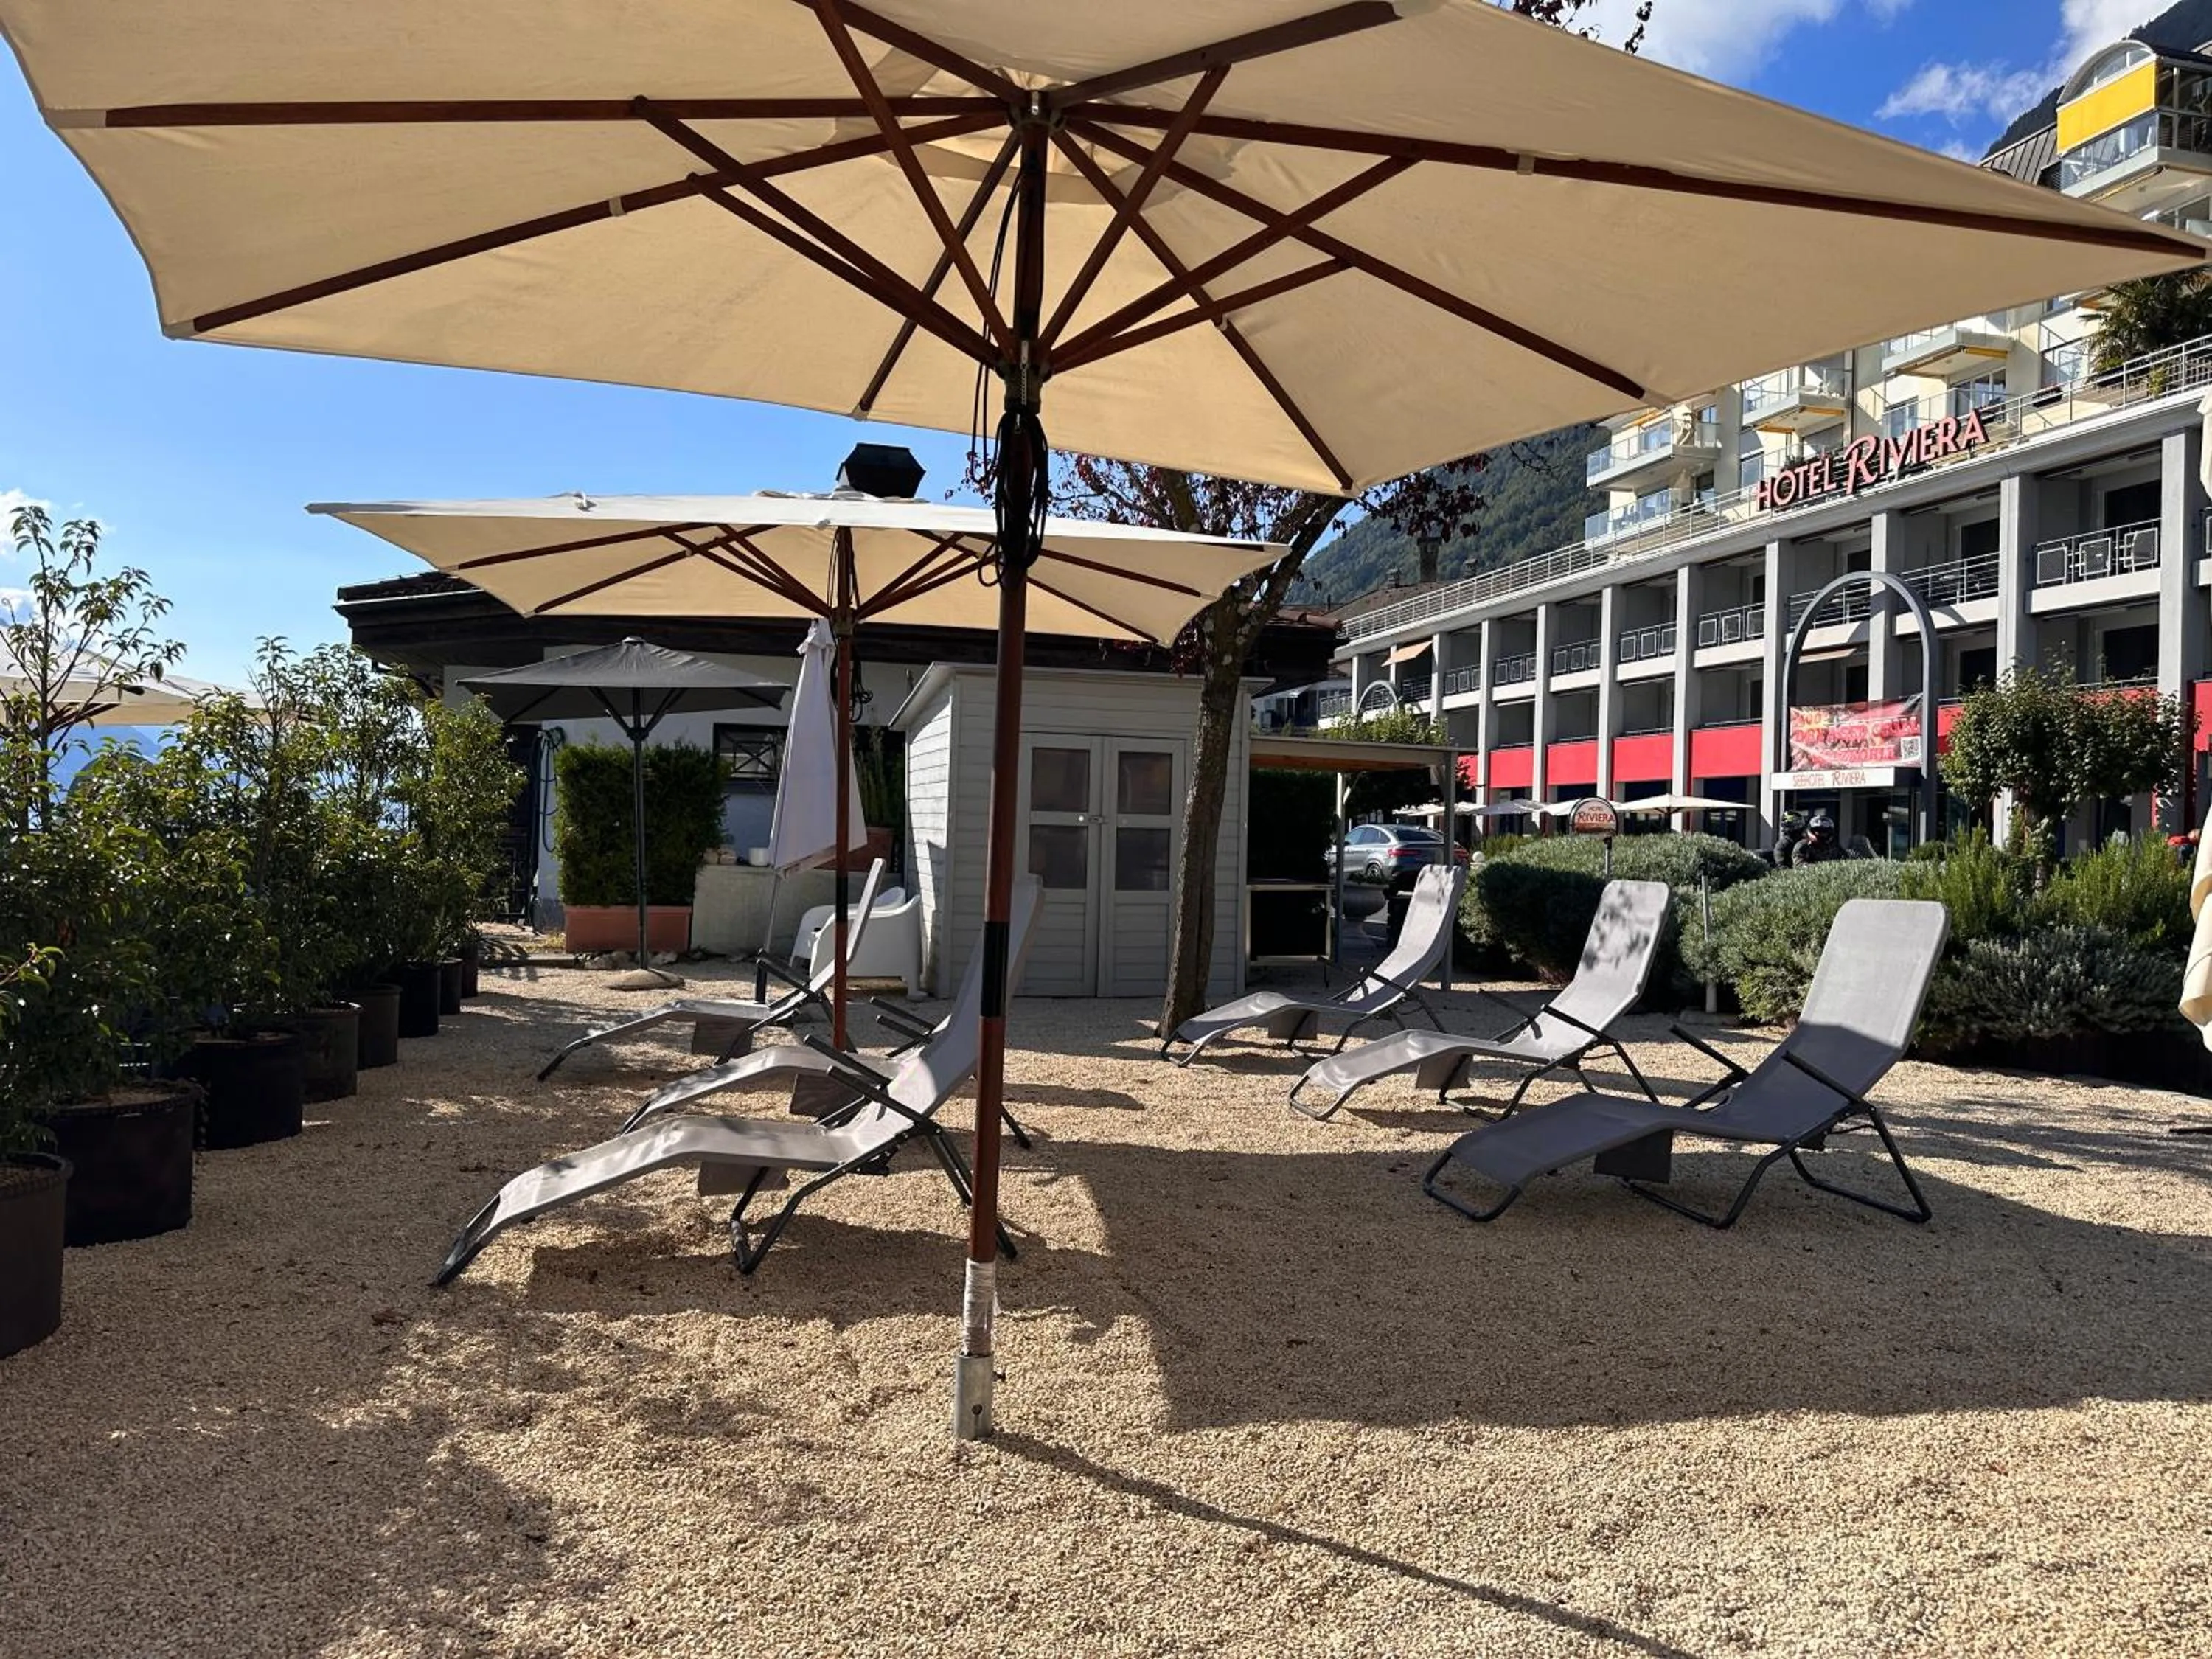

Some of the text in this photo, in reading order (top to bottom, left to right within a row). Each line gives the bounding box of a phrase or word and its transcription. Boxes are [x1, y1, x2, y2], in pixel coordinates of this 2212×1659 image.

[1756, 409, 1989, 511] HOTEL RIVIERA
[1831, 771, 1867, 786] RIVIERA
[1577, 811, 1615, 822] RIVIERA
